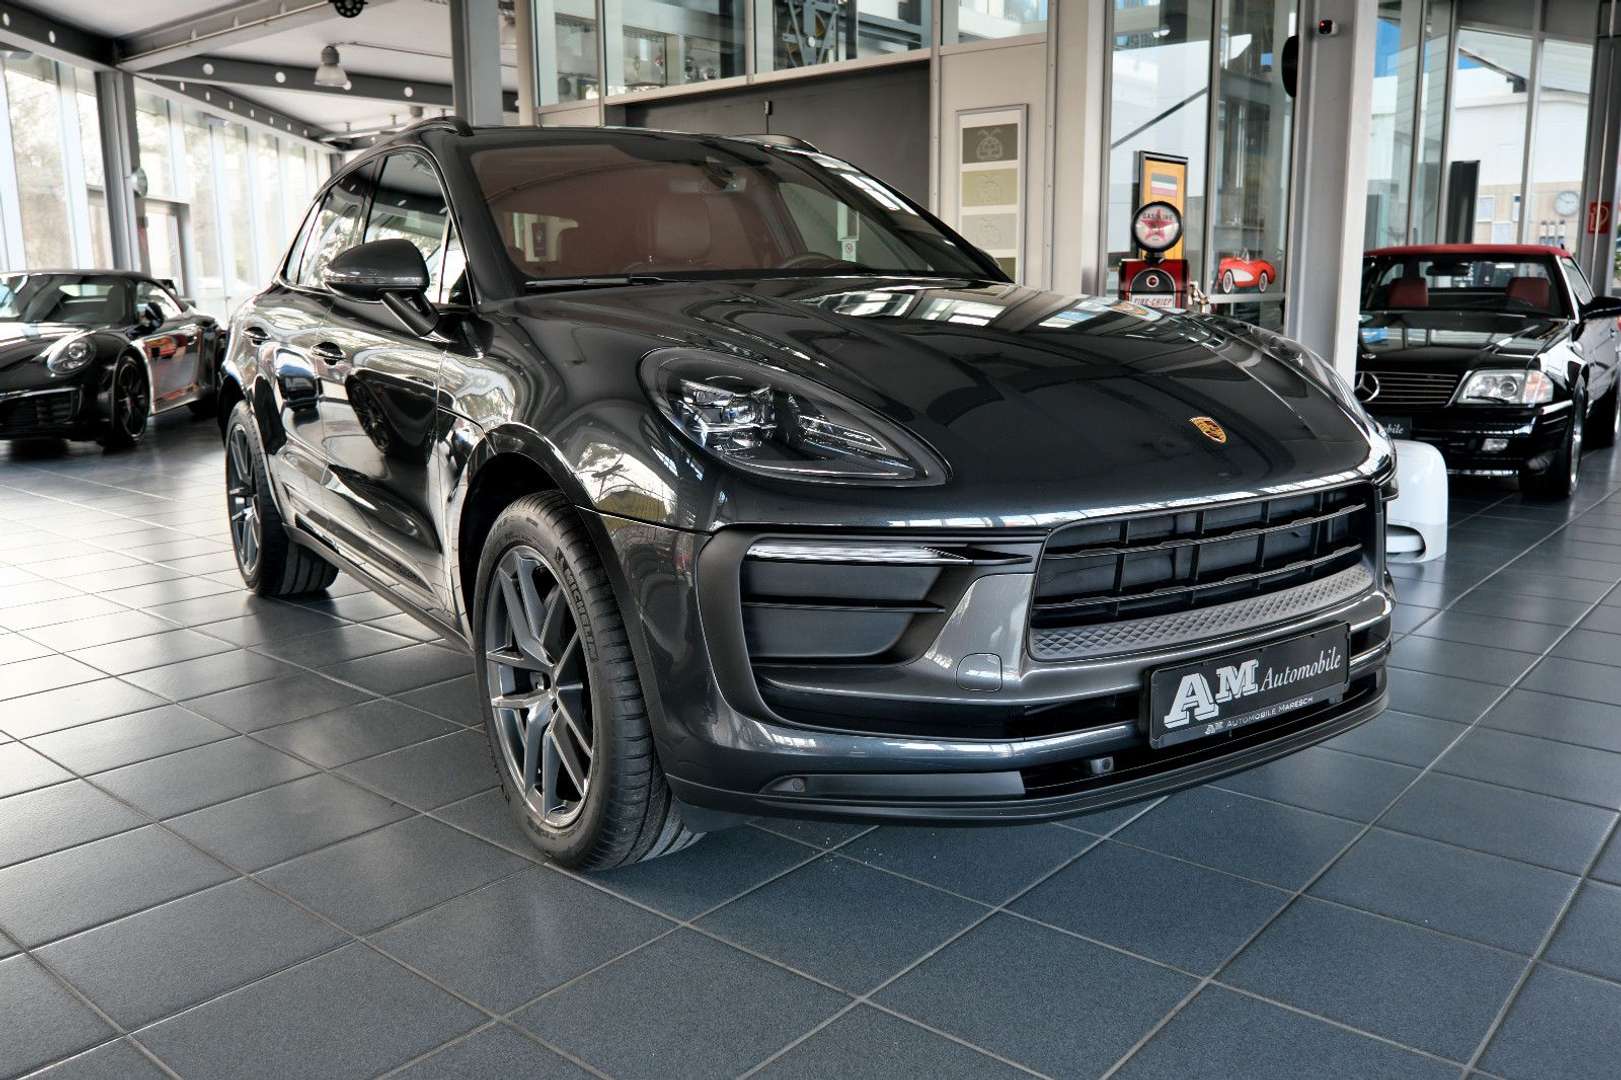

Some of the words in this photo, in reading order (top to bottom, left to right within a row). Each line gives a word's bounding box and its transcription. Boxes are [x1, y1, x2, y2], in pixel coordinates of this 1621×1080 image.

[1163, 659, 1260, 729] AM
[1260, 646, 1342, 691] Automobile
[1226, 708, 1277, 728] AUTOMOBILE
[1279, 697, 1314, 713] MARESCH
